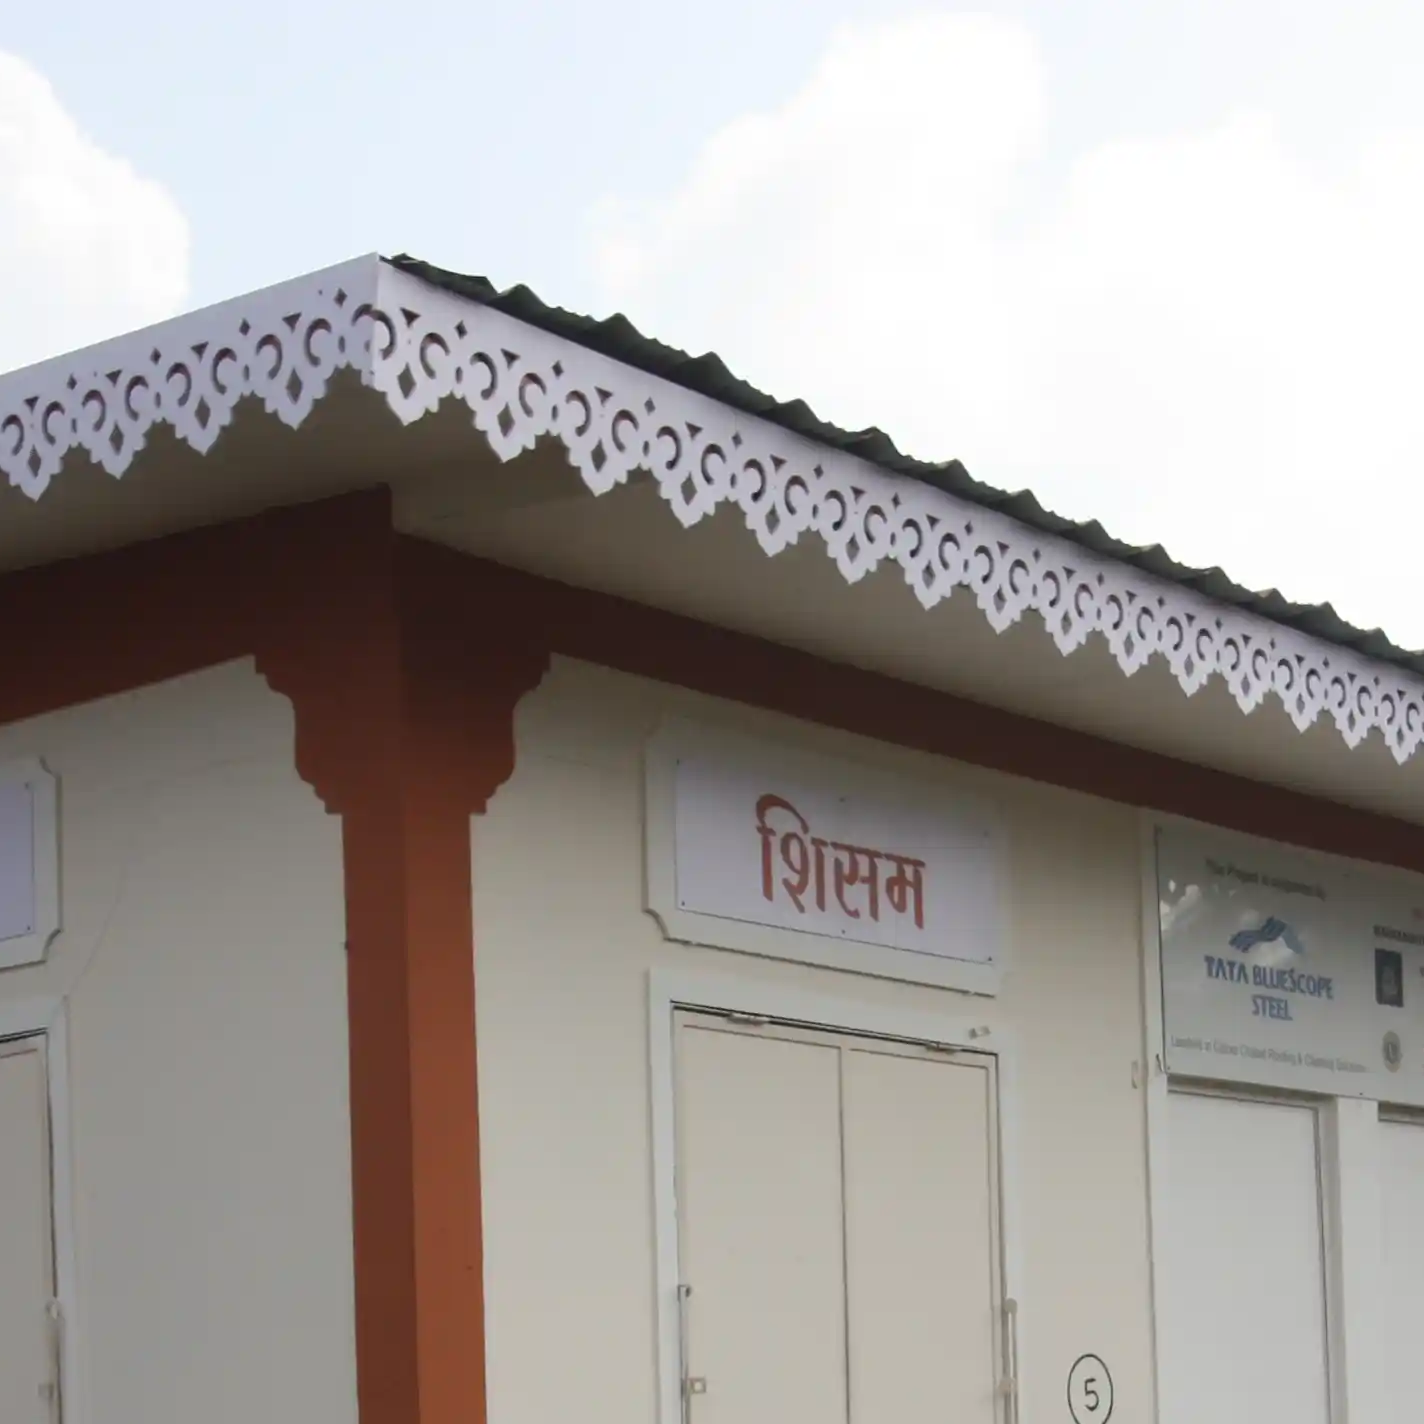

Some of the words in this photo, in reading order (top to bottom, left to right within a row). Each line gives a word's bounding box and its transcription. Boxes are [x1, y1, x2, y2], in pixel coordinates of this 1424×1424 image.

[756, 793, 925, 929] शिसम
[1204, 955, 1249, 985] TATA
[1252, 963, 1334, 1000] BLUESCOPE
[1251, 994, 1292, 1021] STEEL
[1084, 1377, 1099, 1411] 5
